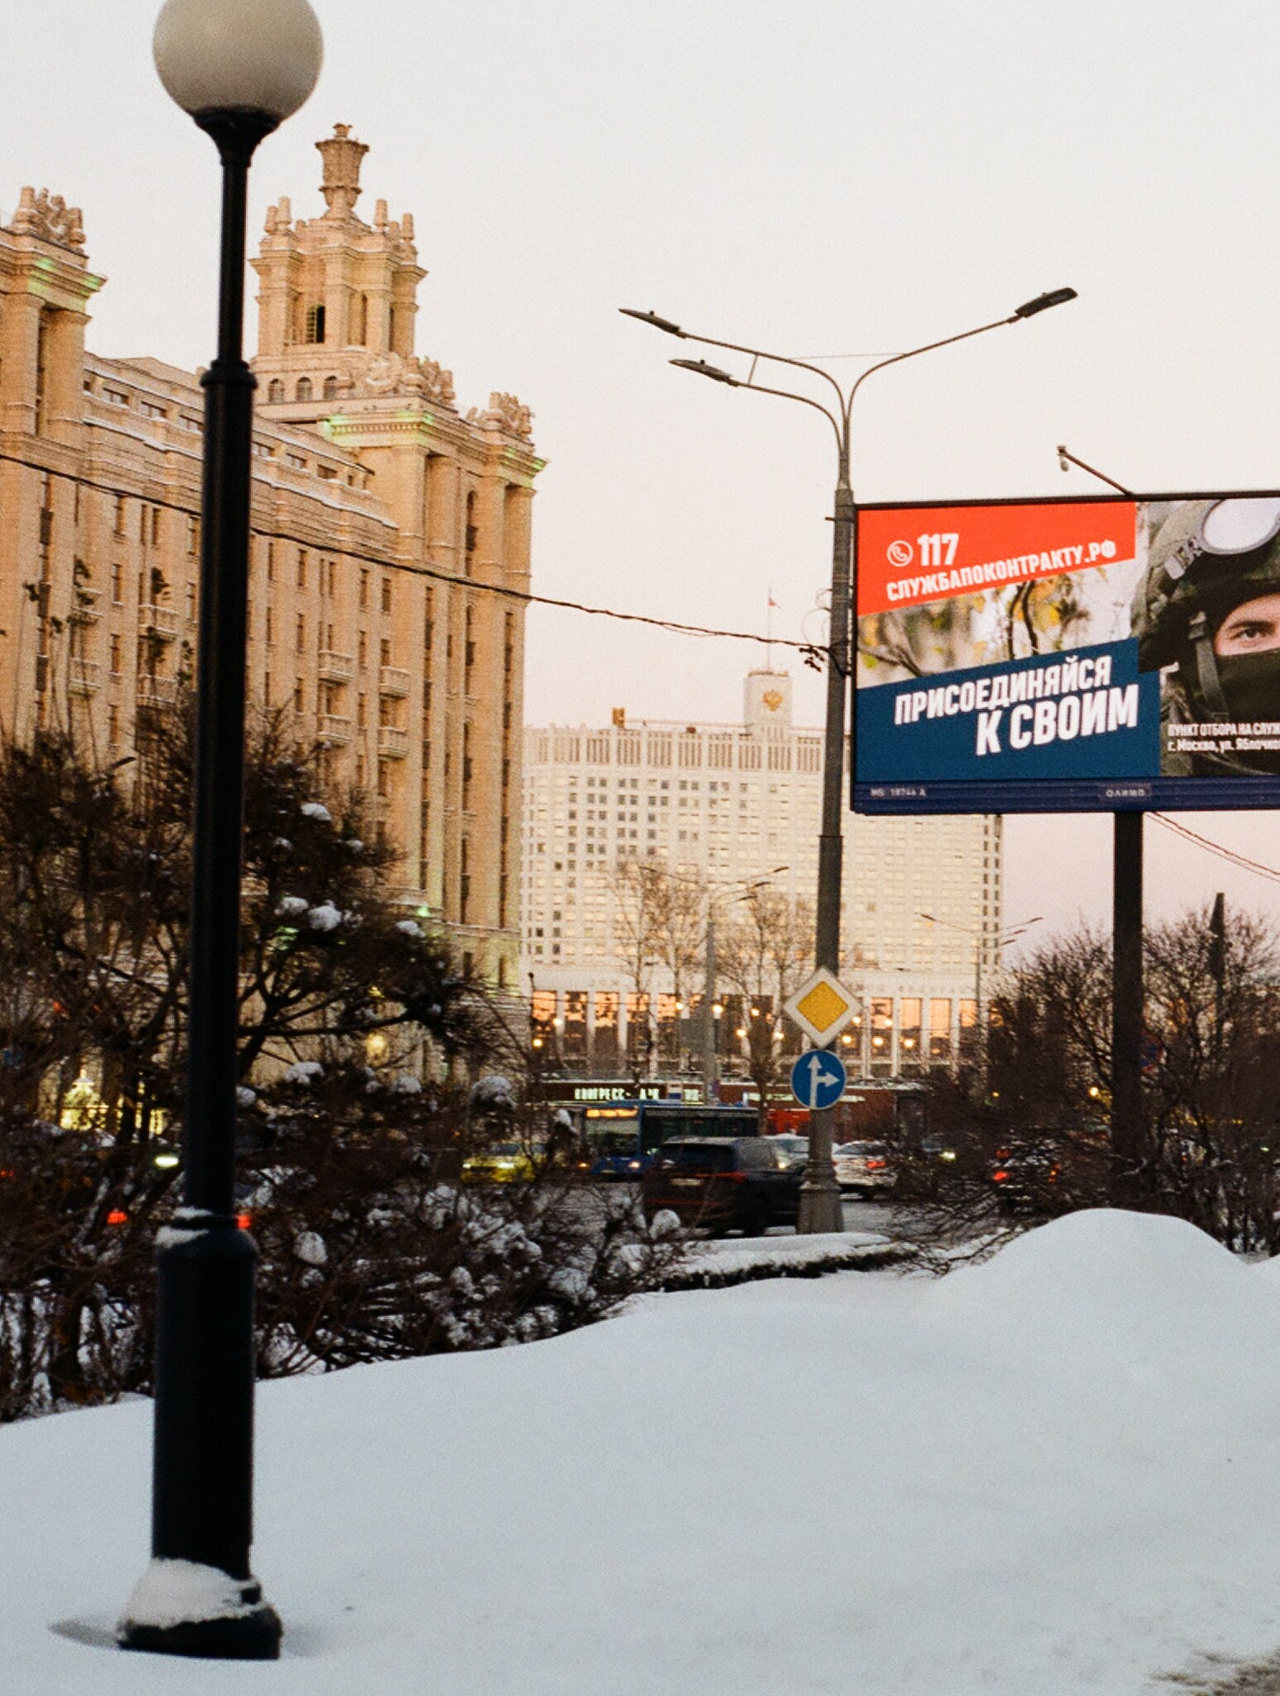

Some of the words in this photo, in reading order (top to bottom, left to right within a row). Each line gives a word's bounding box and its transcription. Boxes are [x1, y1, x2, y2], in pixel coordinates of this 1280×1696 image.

[886, 539, 1117, 601] СЛУЖБАПОКОНТРАКТУ.РФ
[916, 533, 960, 566] 117
[894, 655, 1112, 725] ПРИСОЕДИНЯЙСЯ
[975, 709, 1003, 756] К
[1009, 684, 1140, 749] СВОИМ
[1167, 723, 1199, 737] ПУНКТ
[1200, 723, 1237, 736] ОТБОРА
[1238, 722, 1252, 735] НА
